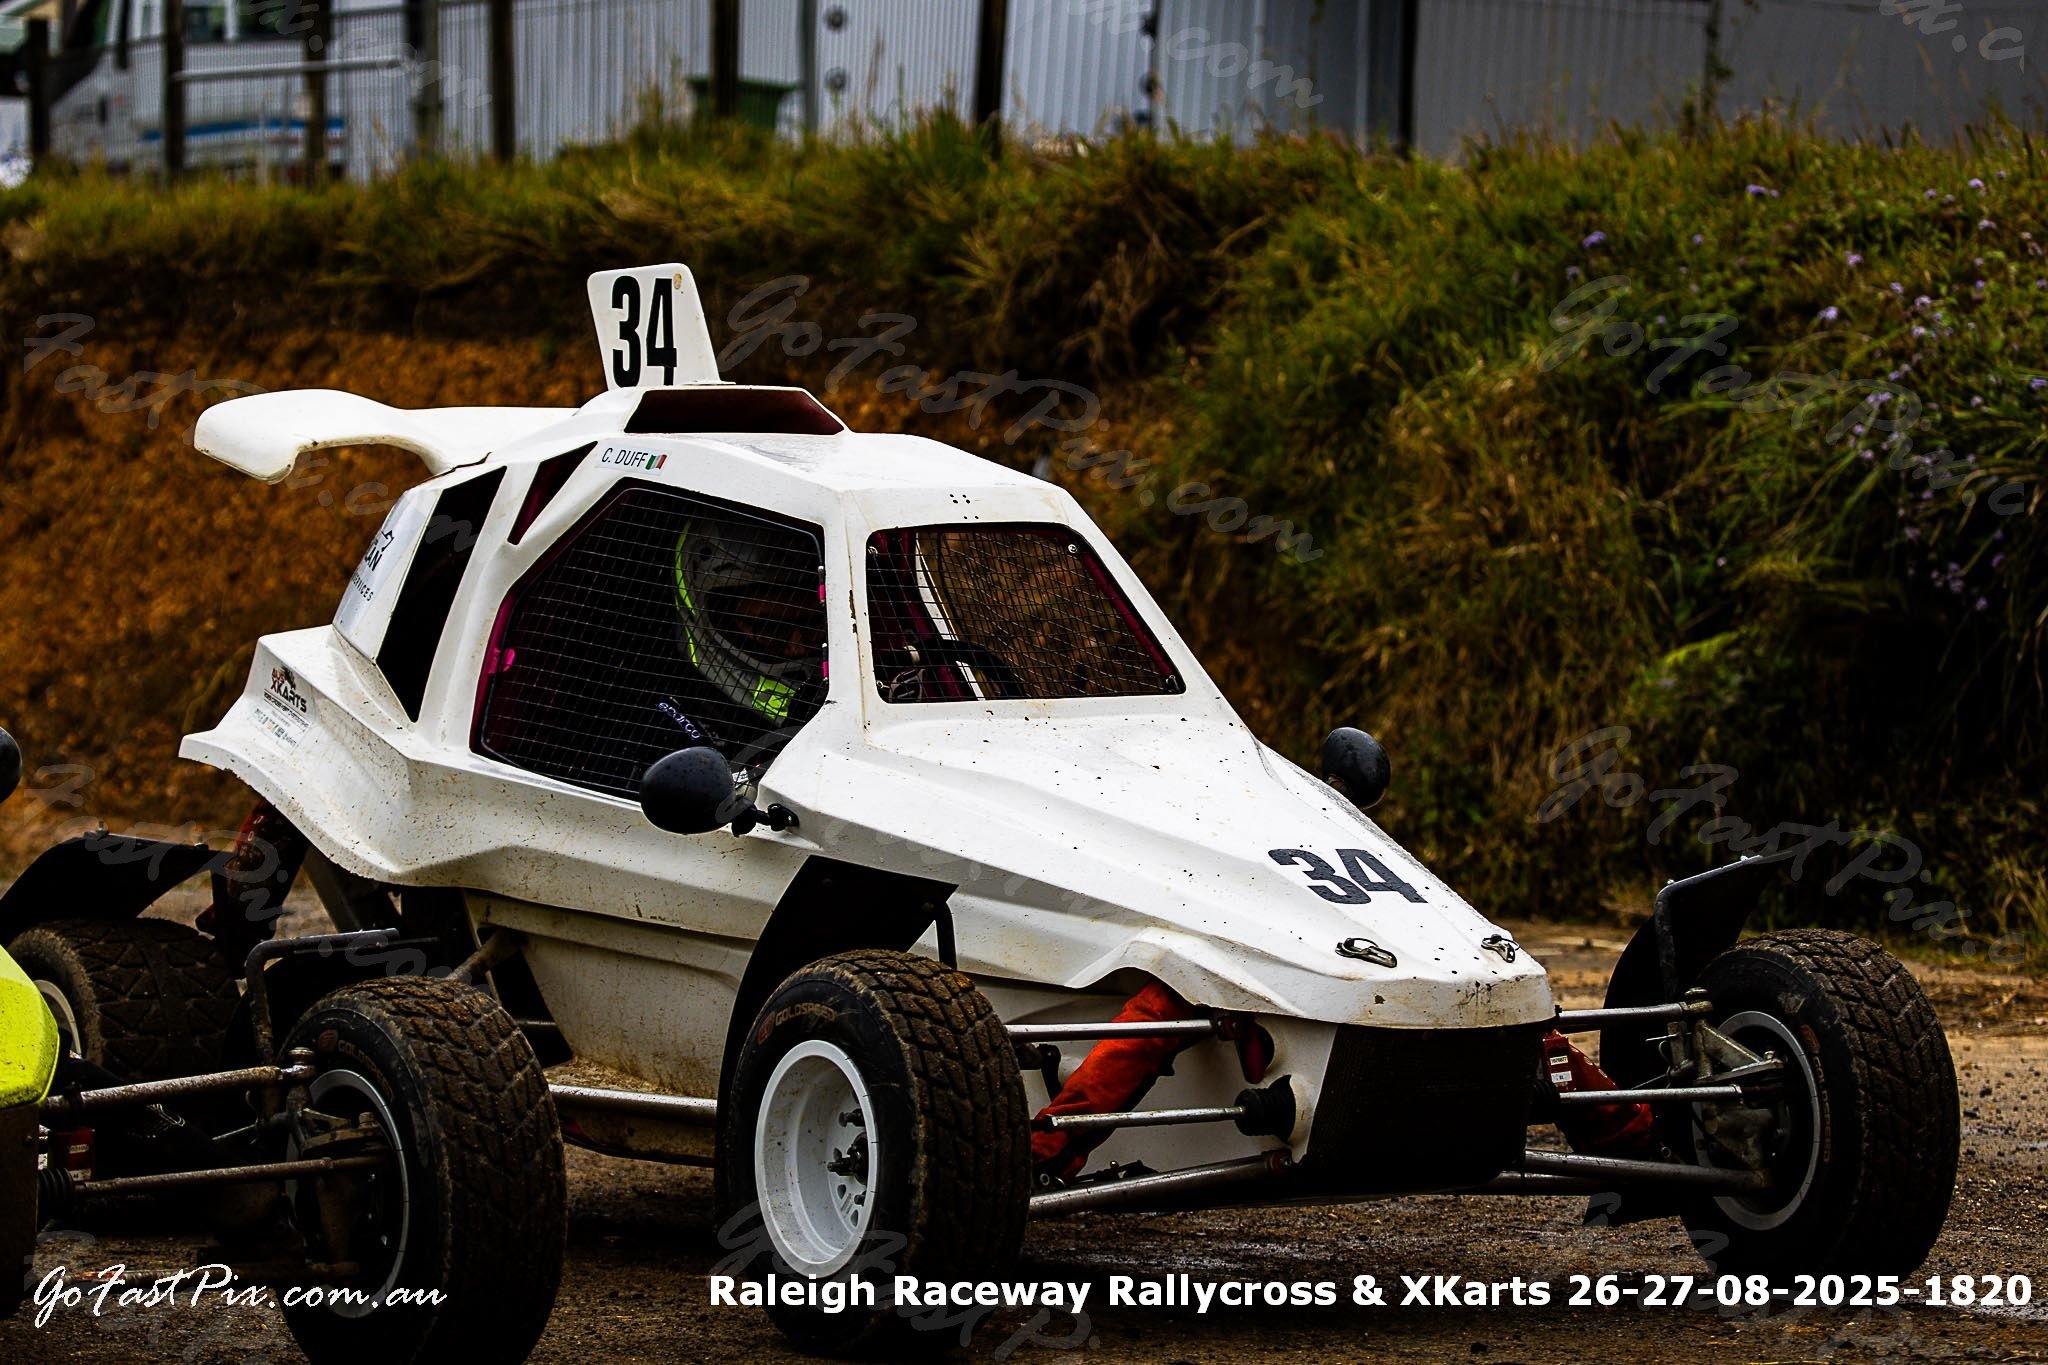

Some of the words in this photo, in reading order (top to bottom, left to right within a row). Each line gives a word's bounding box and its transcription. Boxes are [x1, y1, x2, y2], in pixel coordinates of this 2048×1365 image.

[611, 275, 677, 388] 34
[602, 448, 613, 463] C.
[615, 450, 648, 467] DUFF
[271, 679, 307, 713] XKARTS
[1268, 848, 1428, 904] 34
[776, 1002, 838, 1026] GOLDSPEED
